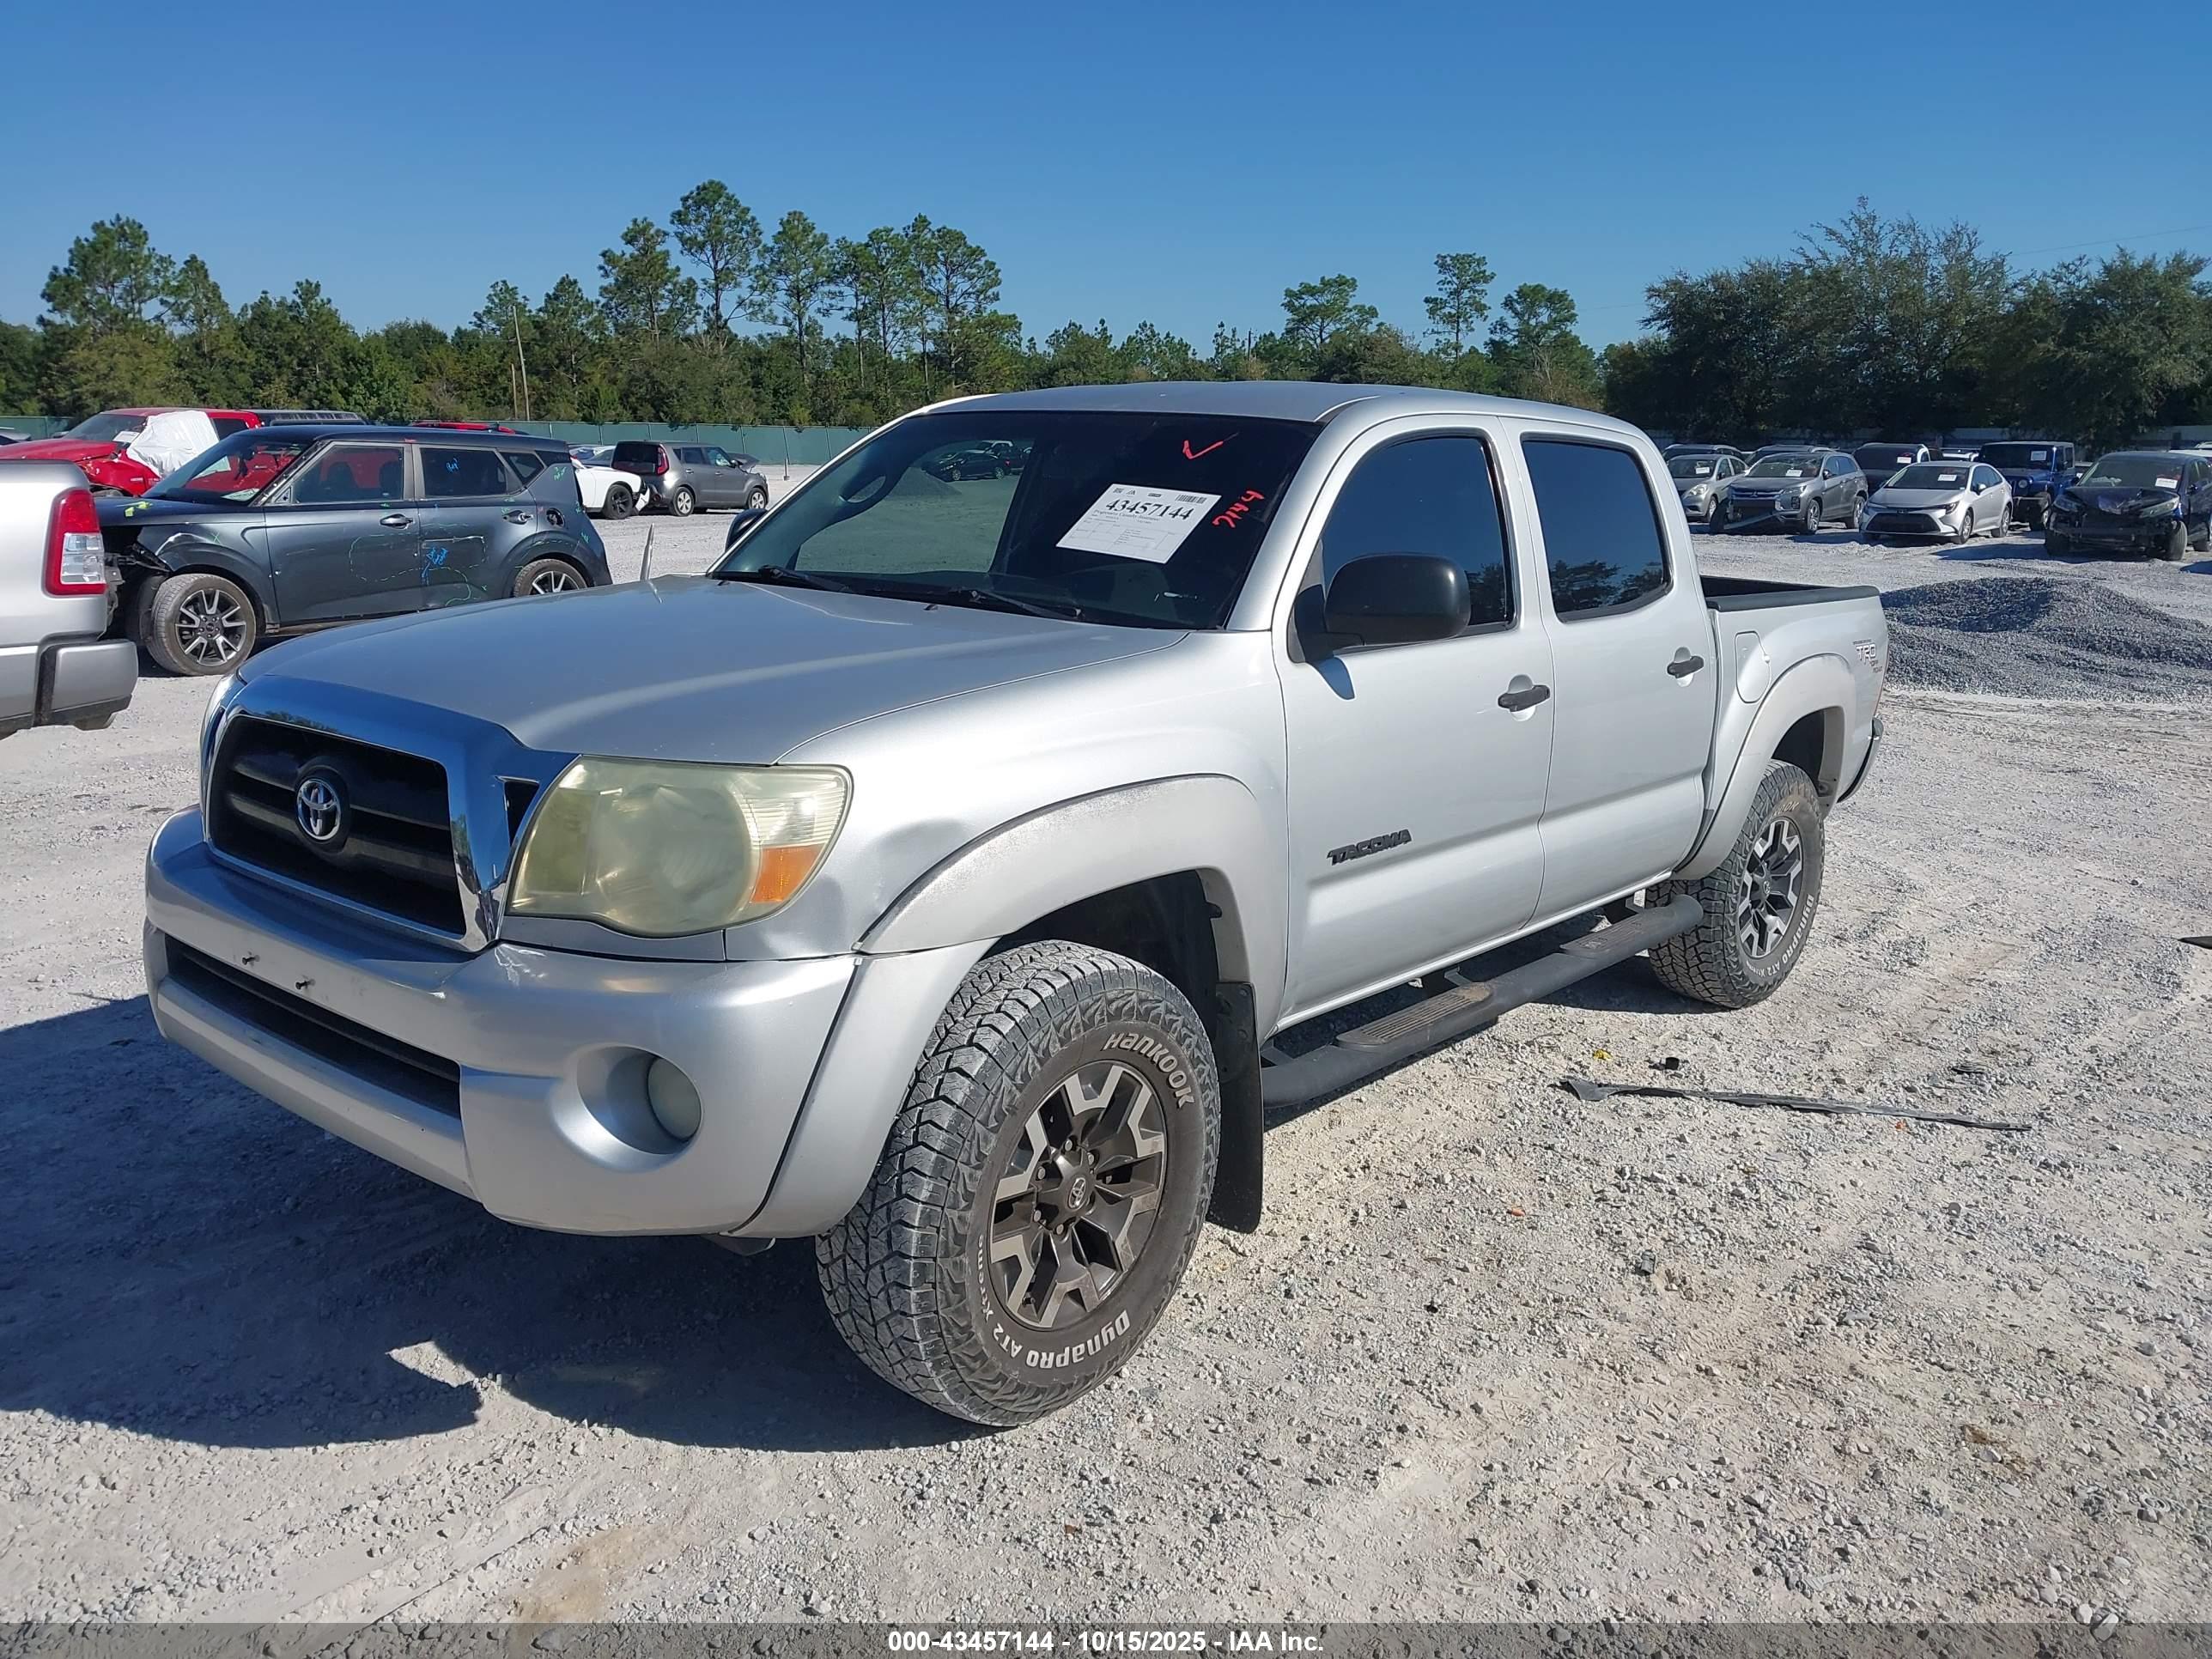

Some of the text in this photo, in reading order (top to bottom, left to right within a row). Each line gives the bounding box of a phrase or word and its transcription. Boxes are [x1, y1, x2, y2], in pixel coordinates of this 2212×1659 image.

[1106, 499, 1194, 520] 43457144
[1327, 829, 1412, 866] TACOMA
[993, 1322, 1023, 1358] AT2
